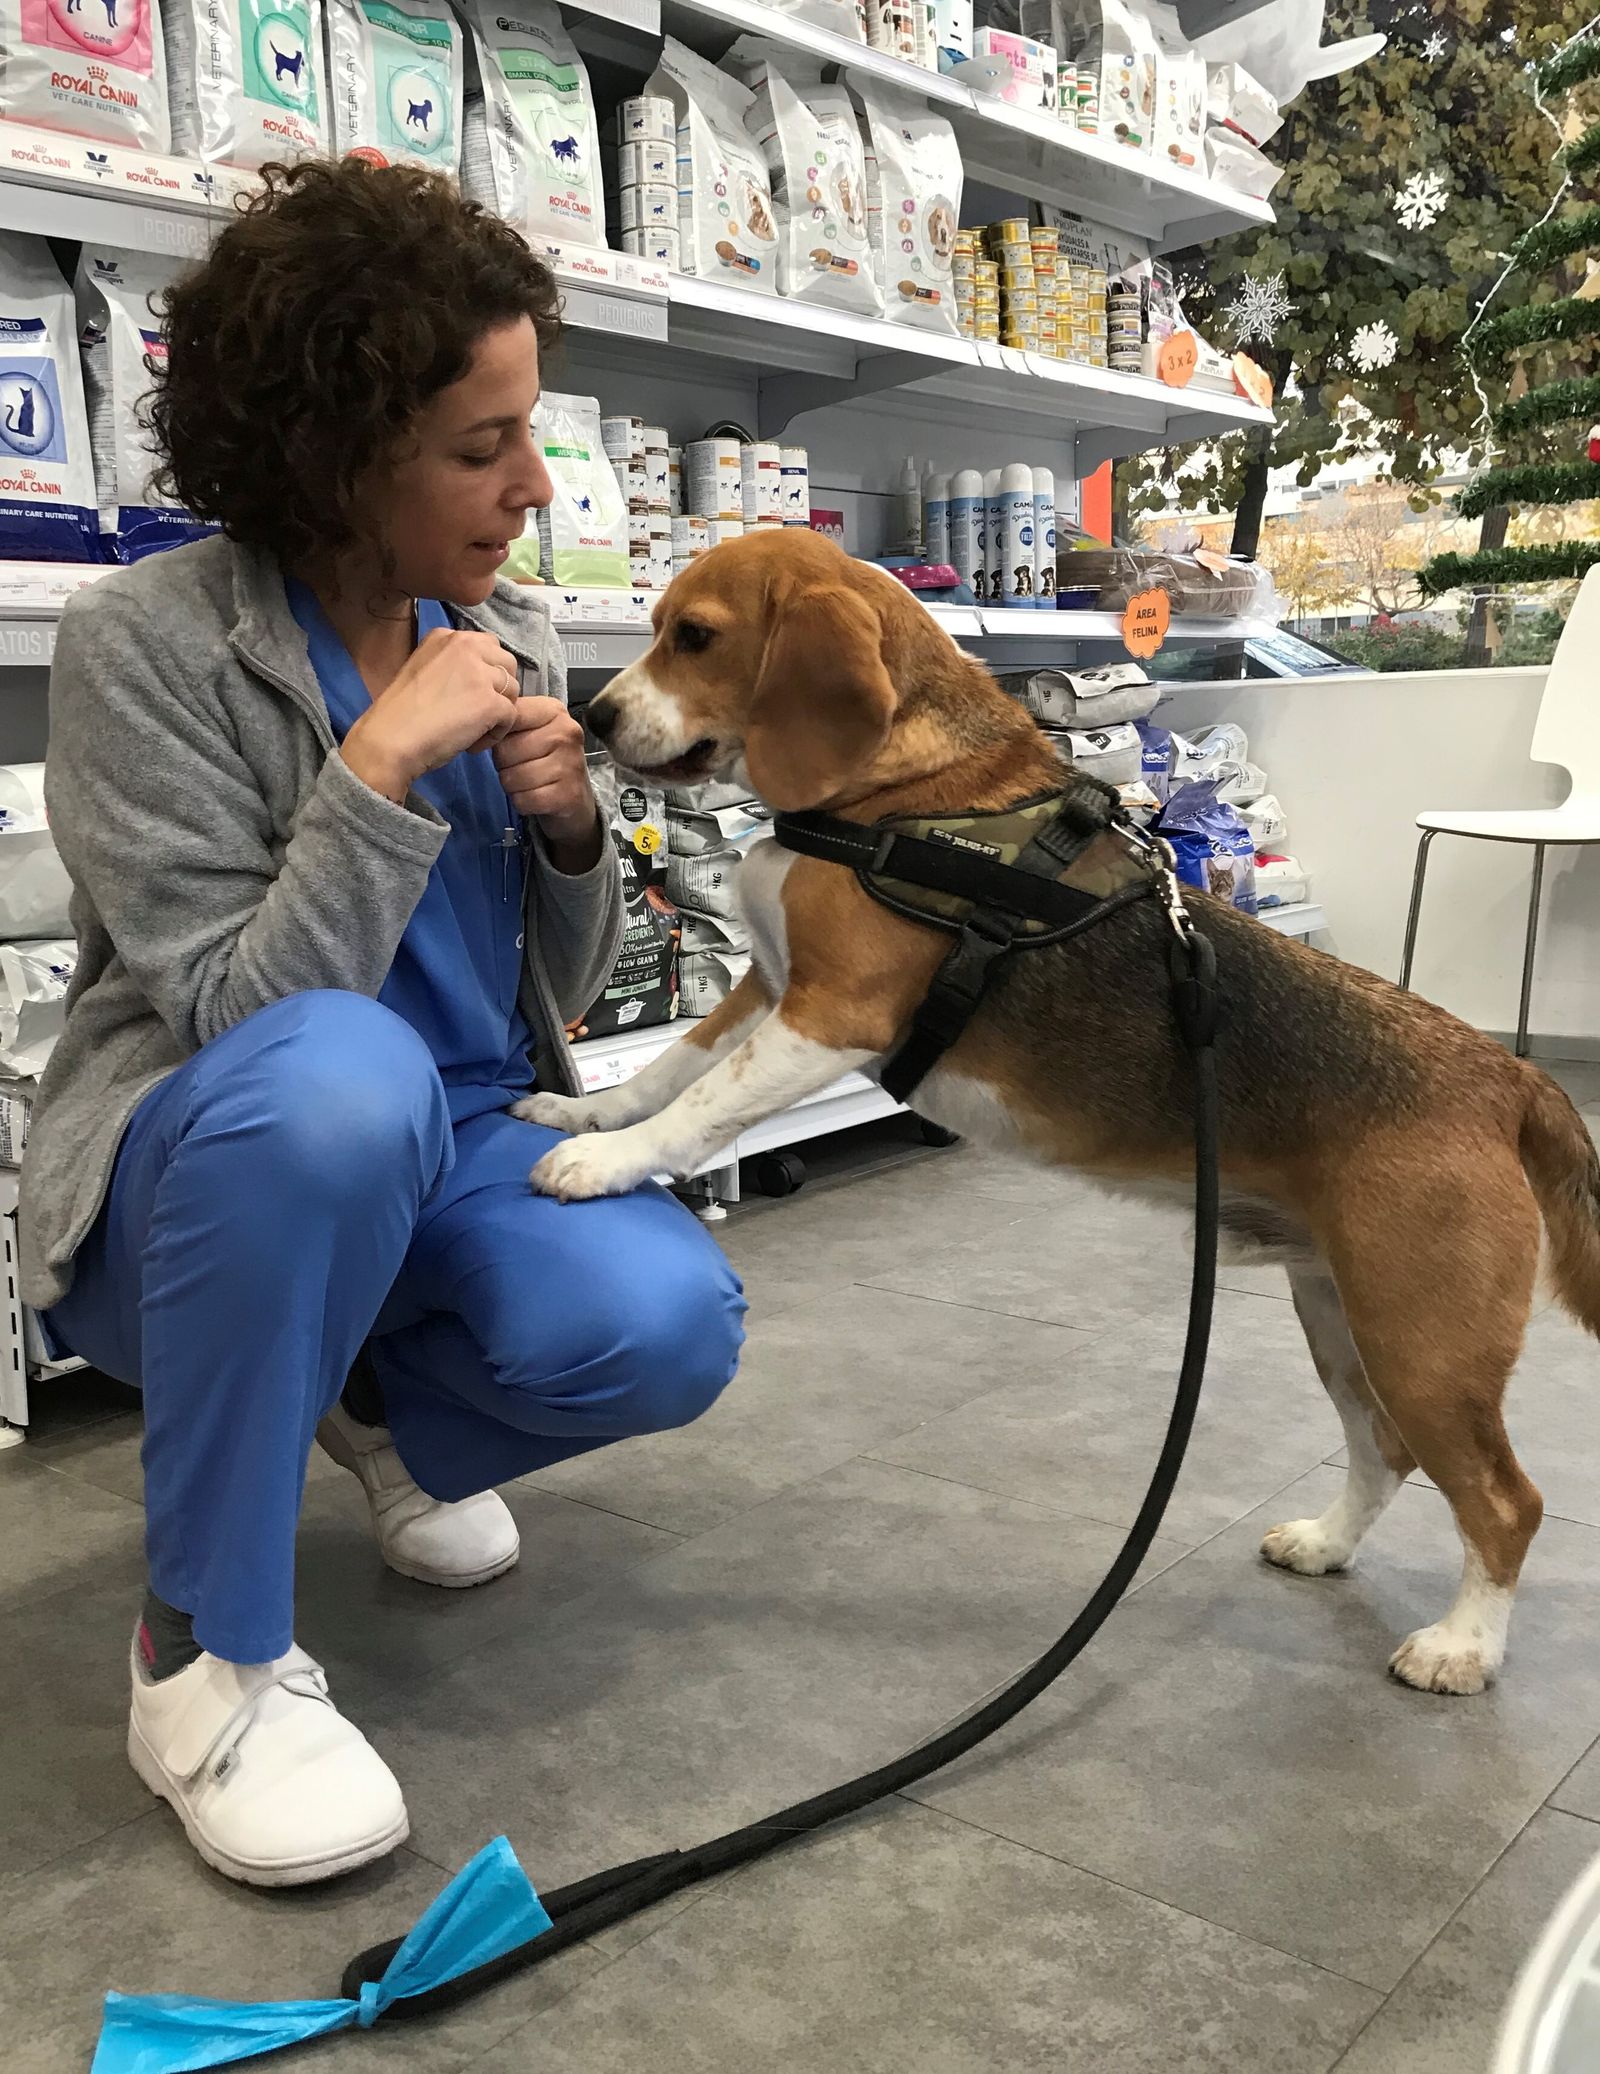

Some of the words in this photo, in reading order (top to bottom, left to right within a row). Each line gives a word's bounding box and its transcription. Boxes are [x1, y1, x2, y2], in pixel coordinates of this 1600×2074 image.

[83, 31, 113, 46] CANINE
[51, 72, 96, 97] ROYAL
[99, 84, 138, 108] CANIN
[346, 53, 359, 138] VETERINARY
[52, 91, 69, 102] VET
[71, 96, 93, 108] CARE
[96, 102, 136, 118] NUTRITON
[262, 118, 291, 138] ROYAL
[11, 149, 40, 163] ROYAL
[42, 155, 71, 169] CANIN
[126, 171, 152, 185] ROYAL
[154, 177, 180, 190] CANIN
[549, 195, 570, 210] ROYAL
[572, 201, 591, 215] CANIN
[143, 218, 208, 250] PERROS
[598, 303, 655, 330] PEQUEÑOS
[1168, 356, 1175, 371] 3
[1186, 350, 1193, 364] 2
[0, 479, 28, 492] OYAL
[31, 482, 61, 495] CANIN
[25, 510, 43, 518] CARE
[45, 511, 79, 521] NUTRITION
[1132, 625, 1158, 639] FELINA
[560, 641, 597, 662] ATITOS
[712, 872, 722, 890] 4KG
[626, 907, 649, 930] tural
[623, 925, 655, 943] GREDIENTS
[623, 958, 636, 969] LOW
[637, 955, 654, 966] GRAIN
[698, 975, 709, 993] 4KG
